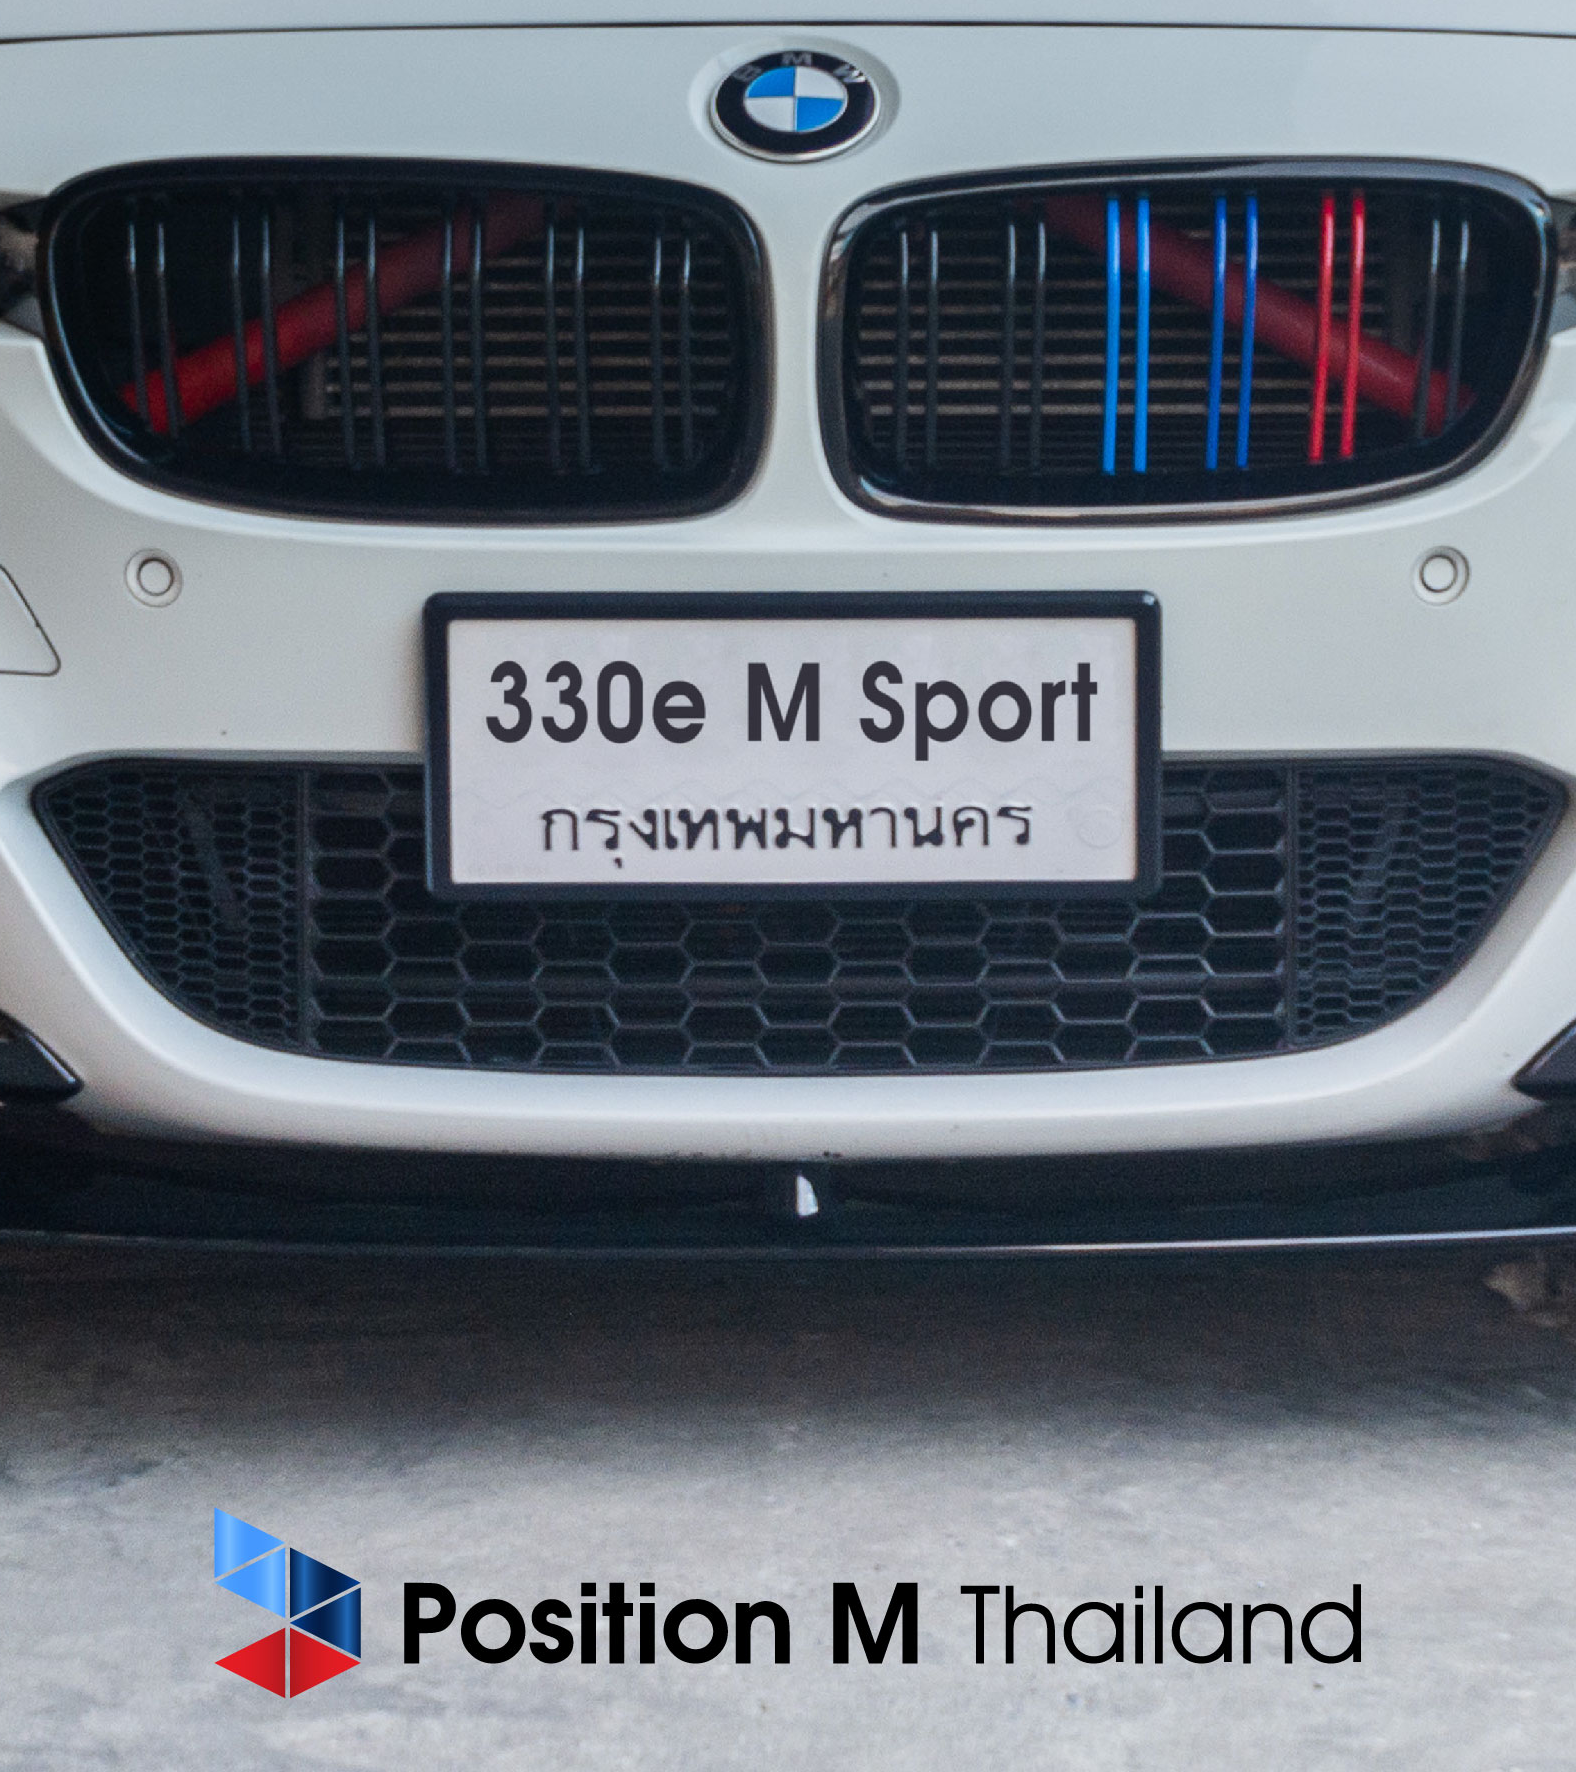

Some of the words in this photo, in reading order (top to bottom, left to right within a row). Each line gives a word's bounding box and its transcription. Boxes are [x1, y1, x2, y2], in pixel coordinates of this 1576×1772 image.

[485, 660, 707, 744] 330e
[747, 662, 821, 742] M
[859, 659, 1099, 761] Sport
[540, 802, 1034, 868] กรุงเทพมหานคร
